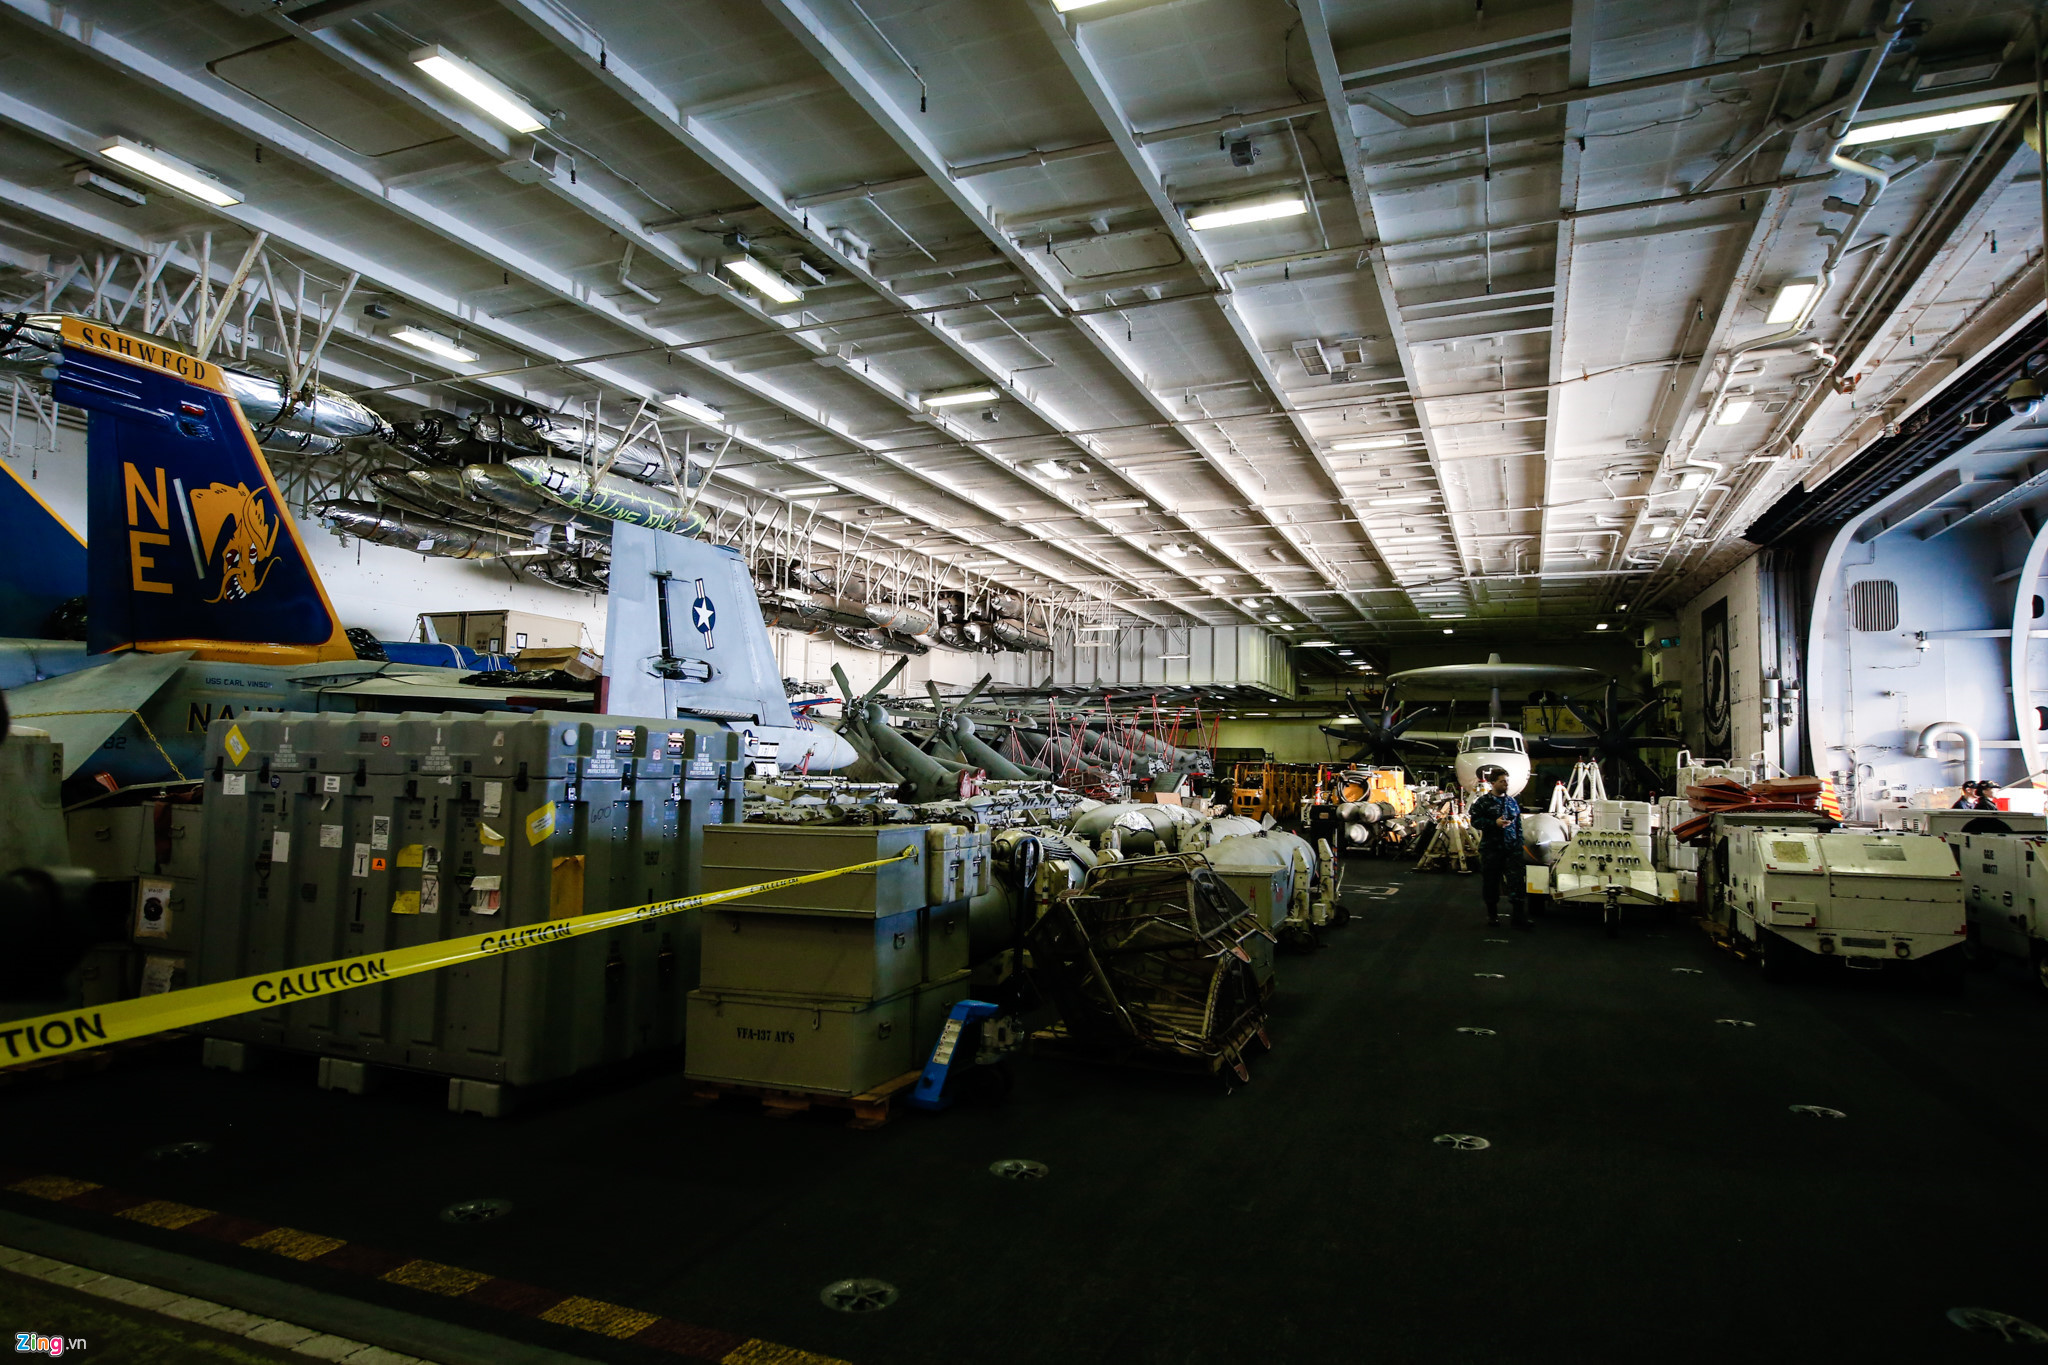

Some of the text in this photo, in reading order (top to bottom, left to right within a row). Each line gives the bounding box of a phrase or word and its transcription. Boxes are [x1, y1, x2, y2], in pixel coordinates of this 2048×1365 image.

[82, 327, 205, 380] SSHWFGD
[205, 677, 221, 686] USS
[223, 679, 245, 687] CARL
[480, 922, 571, 954] CAUTION
[251, 957, 390, 1004] CAUTION
[736, 1026, 795, 1044] VFA-137 AT'S
